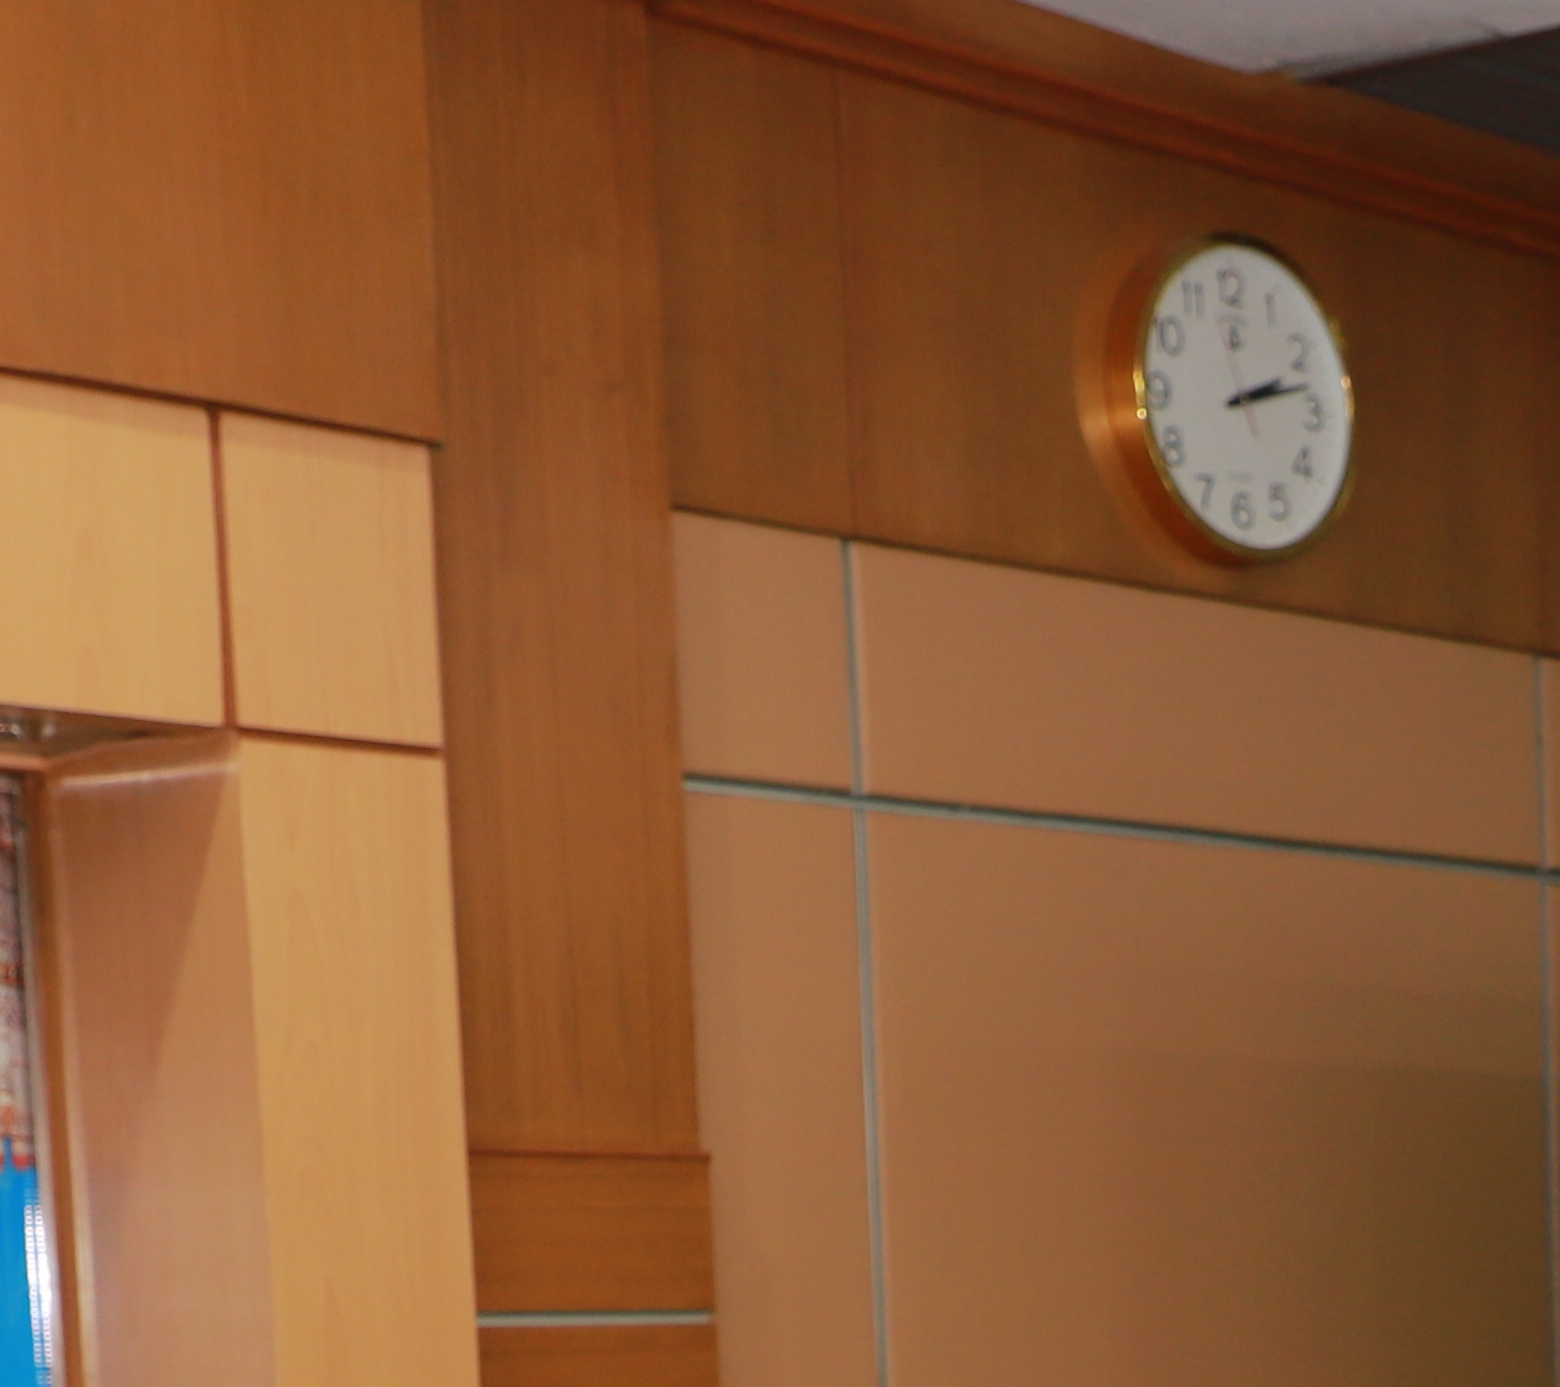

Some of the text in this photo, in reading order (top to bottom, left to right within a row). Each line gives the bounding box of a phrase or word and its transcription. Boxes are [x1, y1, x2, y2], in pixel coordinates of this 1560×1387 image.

[1182, 280, 1204, 318] 11
[1217, 268, 1245, 306] 12
[1266, 293, 1276, 326] 1
[1154, 314, 1185, 357] 10
[1288, 333, 1310, 372] 2
[1147, 369, 1171, 409] 9
[1305, 393, 1323, 432] 3
[1161, 424, 1184, 466] 8
[1292, 446, 1313, 479] 4
[1196, 473, 1215, 509] 7
[1232, 490, 1255, 529] 6
[1268, 482, 1291, 521] 5
